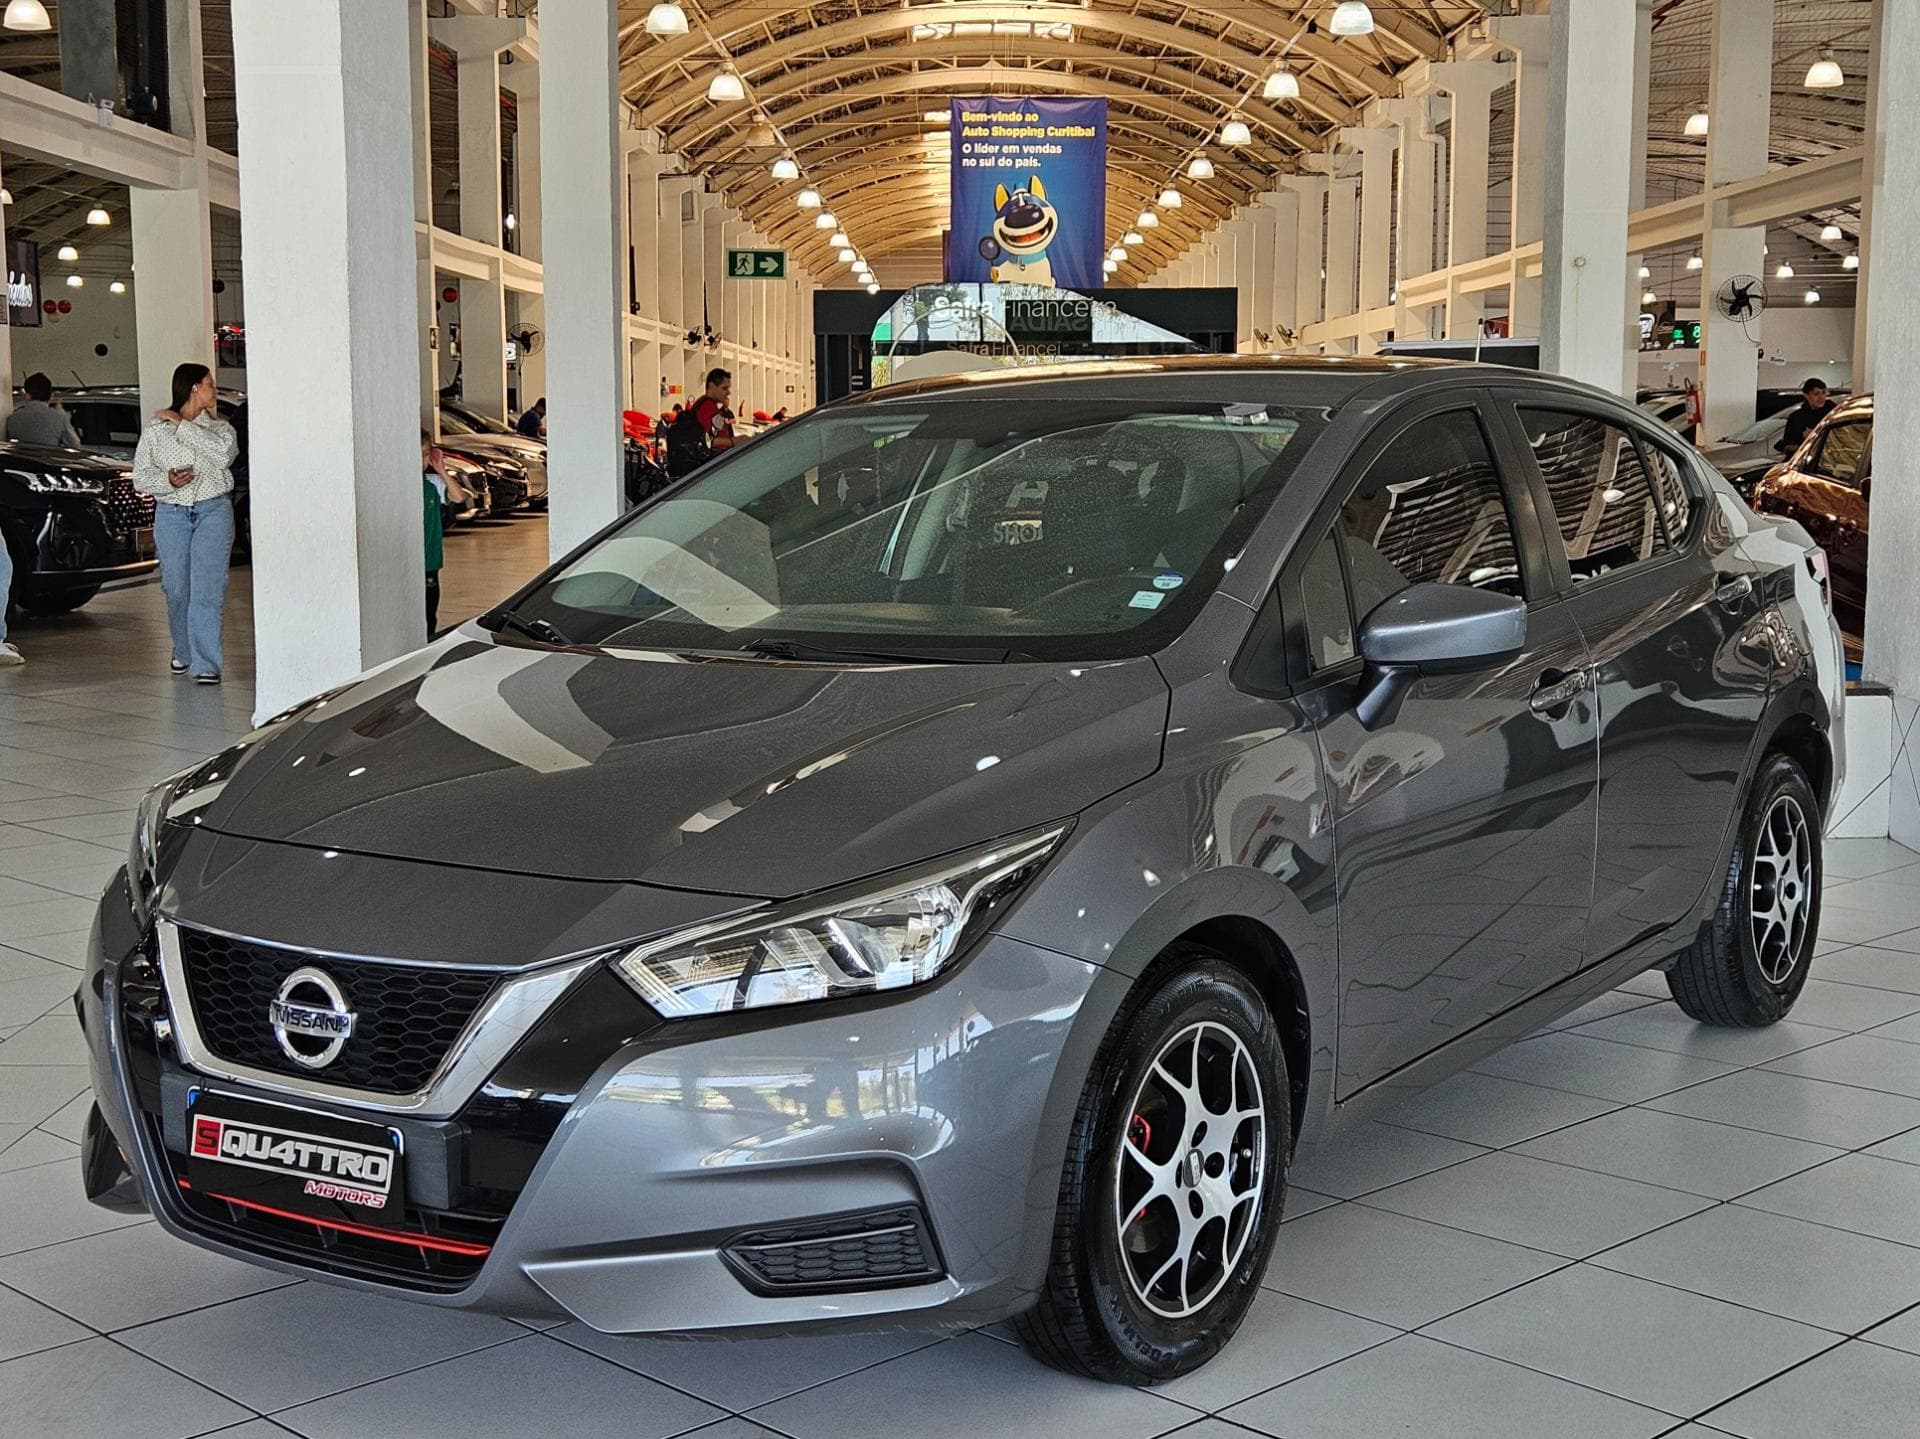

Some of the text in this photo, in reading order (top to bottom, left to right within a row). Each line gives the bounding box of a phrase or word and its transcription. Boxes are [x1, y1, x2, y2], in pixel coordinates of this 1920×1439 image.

[962, 111, 1039, 122] Bem-vindo ao
[962, 126, 1096, 138] Auto Shopping Curitiba!
[962, 142, 1063, 154] O líder em vendas
[962, 156, 1042, 168] no sul do país.
[934, 296, 1117, 318] Safra inance
[275, 1003, 339, 1032] NISSAN
[304, 1179, 388, 1209] MOTORS
